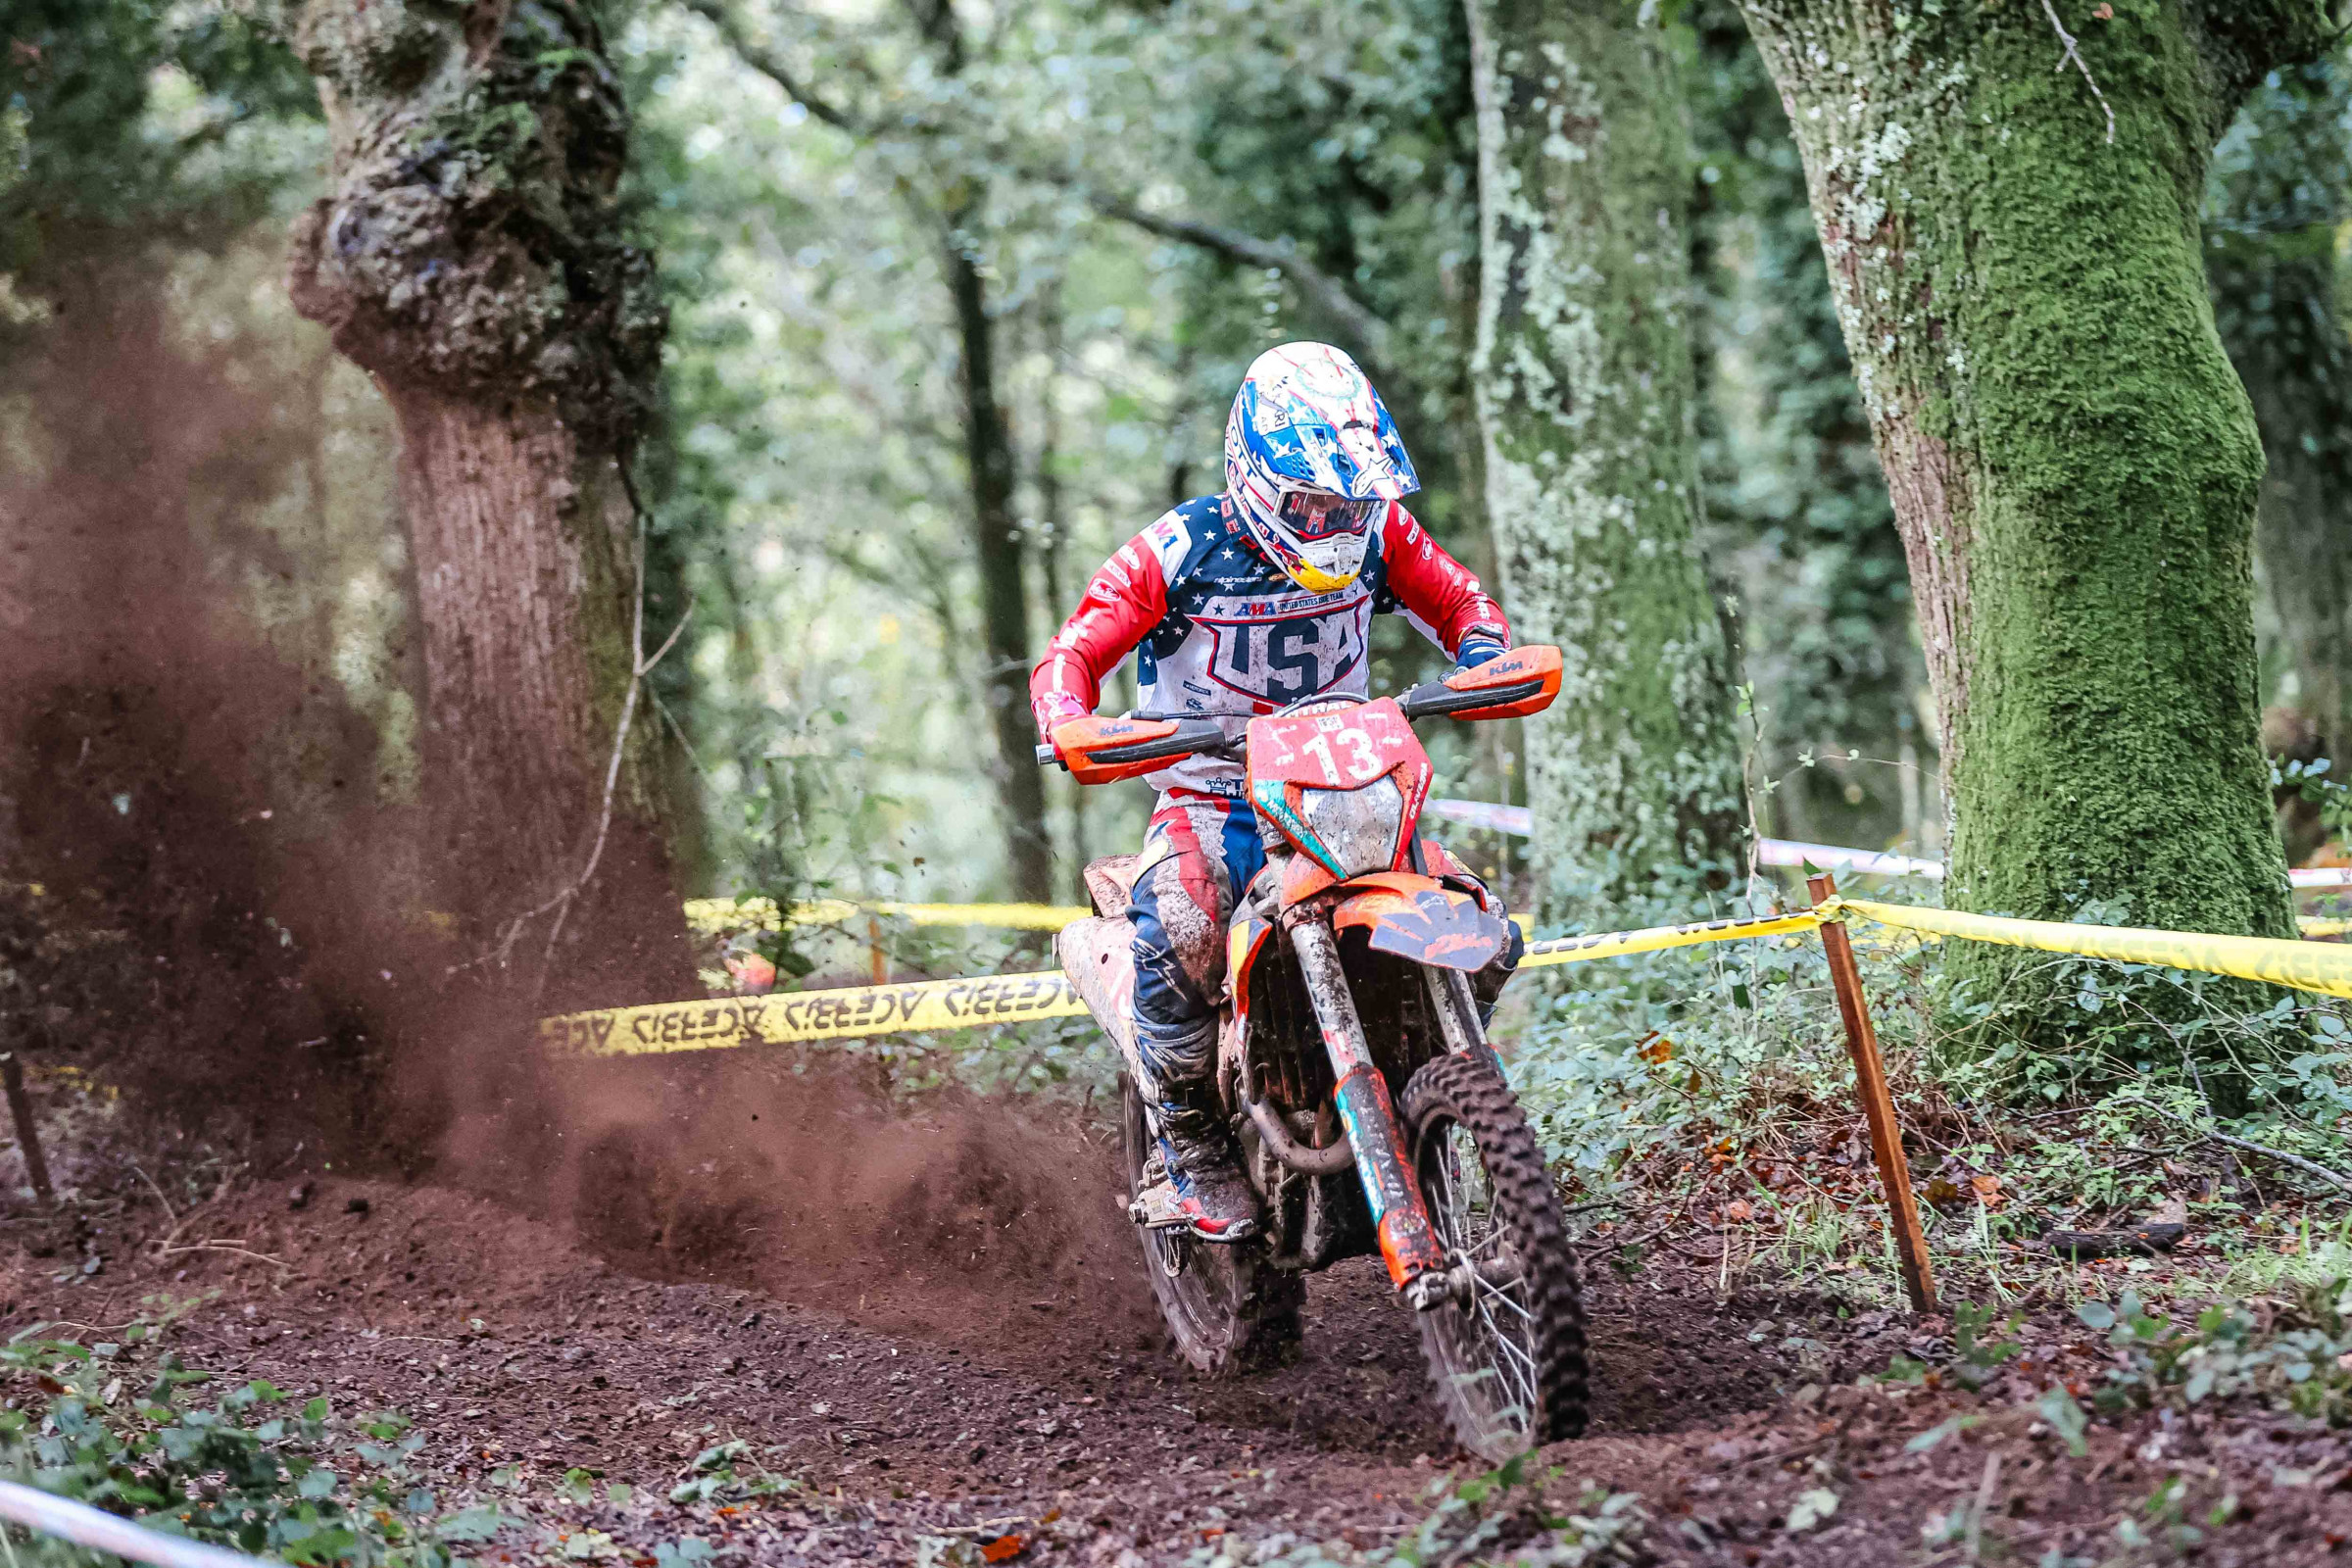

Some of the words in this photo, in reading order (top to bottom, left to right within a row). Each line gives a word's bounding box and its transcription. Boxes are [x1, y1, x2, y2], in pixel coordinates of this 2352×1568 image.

[1234, 602, 1277, 616] AMA
[1278, 600, 1298, 612] UNITED
[1298, 597, 1318, 609] STATES
[1329, 591, 1344, 602] TEAM
[1210, 607, 1358, 704] USA
[1490, 660, 1523, 677] KTM
[1301, 727, 1383, 786] 13
[784, 990, 928, 1029] ACERBIS
